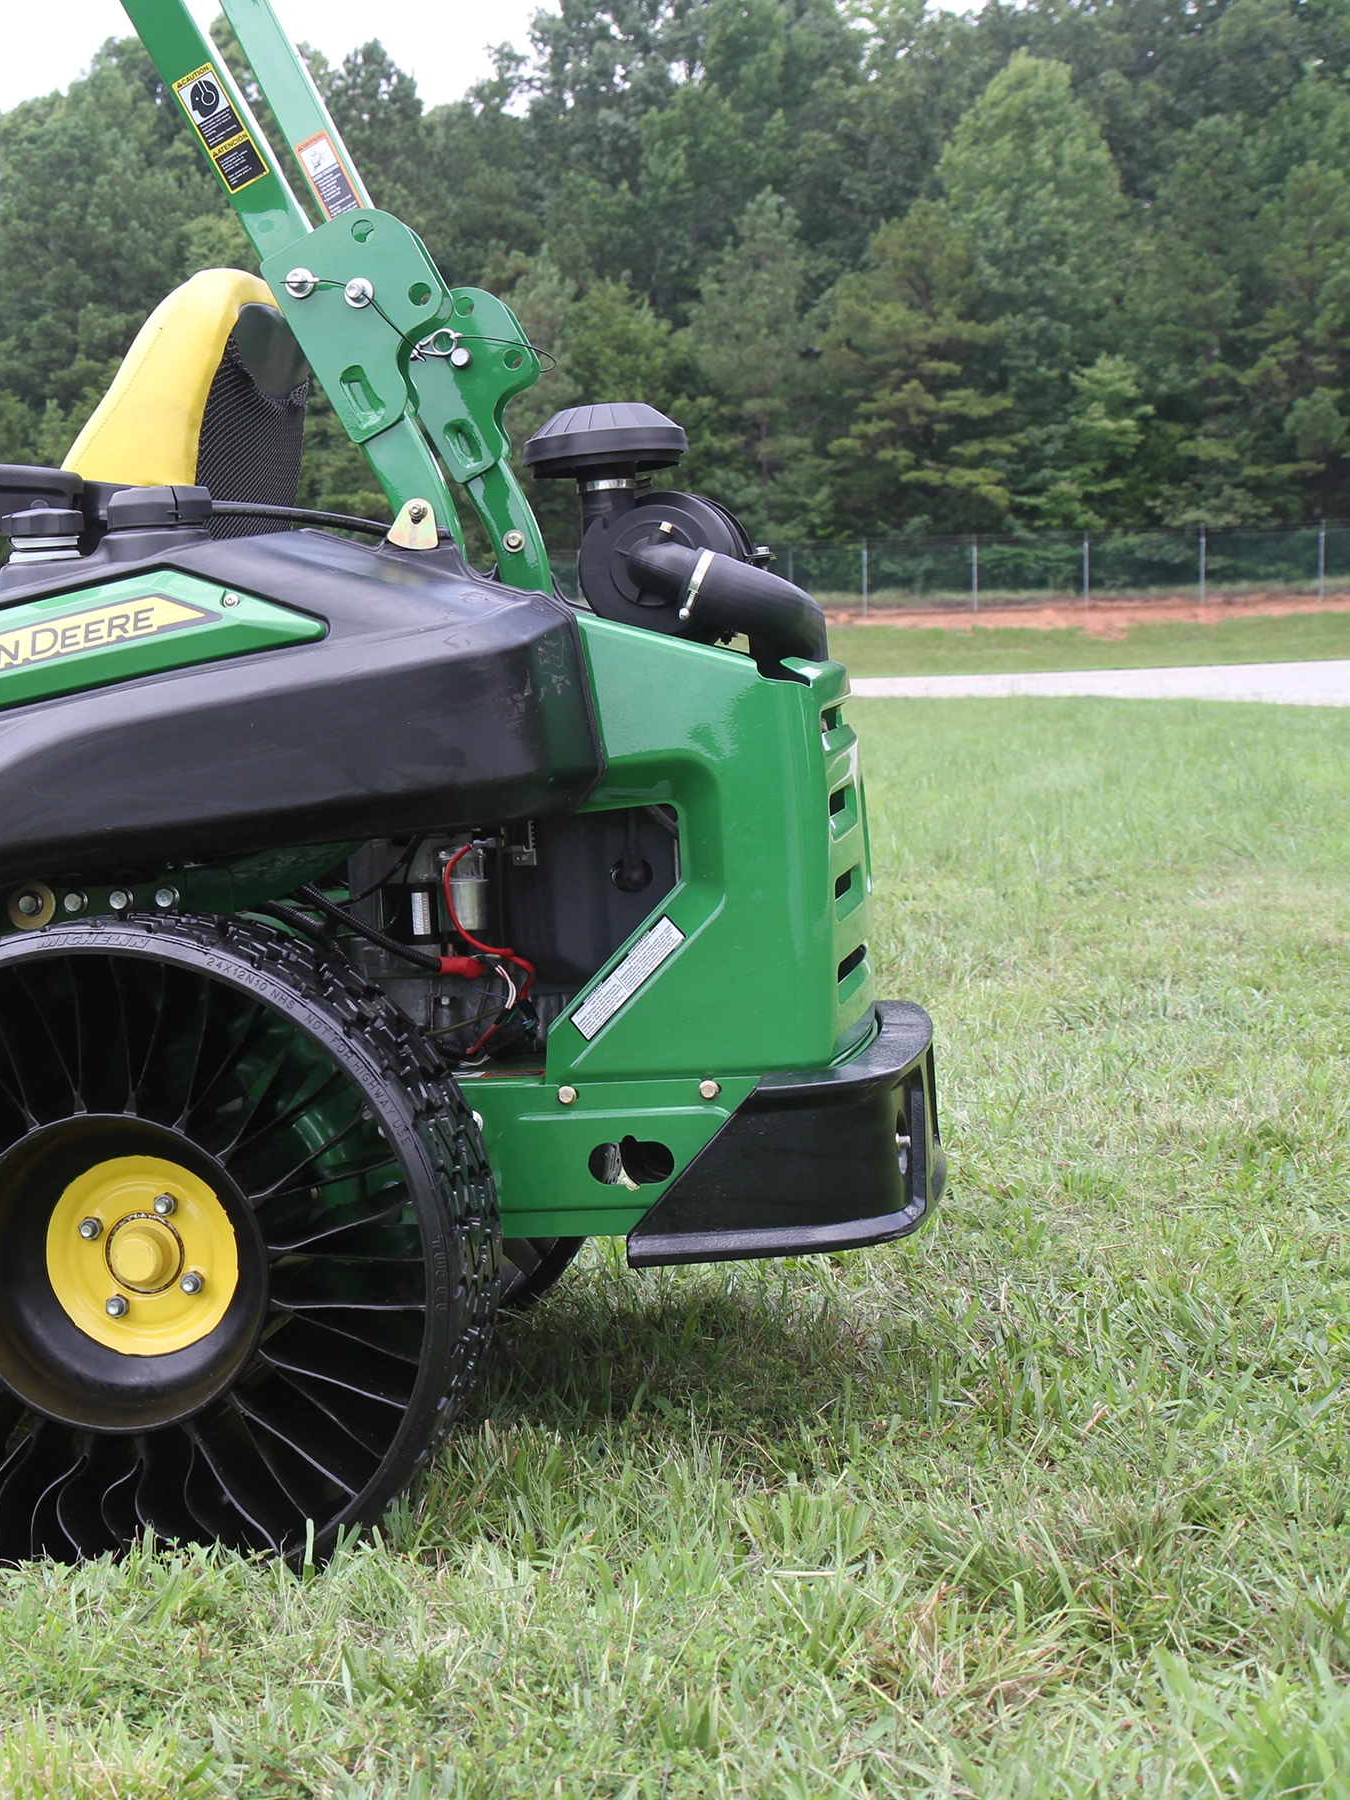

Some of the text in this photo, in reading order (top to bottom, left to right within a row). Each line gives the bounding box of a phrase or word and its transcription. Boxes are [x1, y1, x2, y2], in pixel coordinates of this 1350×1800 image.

[181, 65, 209, 86] CAUTION
[217, 133, 248, 155] ATENCIÓN
[31, 607, 155, 657] DEERE
[36, 933, 151, 949] MICHELIN
[206, 957, 296, 1010] 24X12N10 NHS
[304, 1014, 411, 1146] NOT FOR HIGHWAY USE
